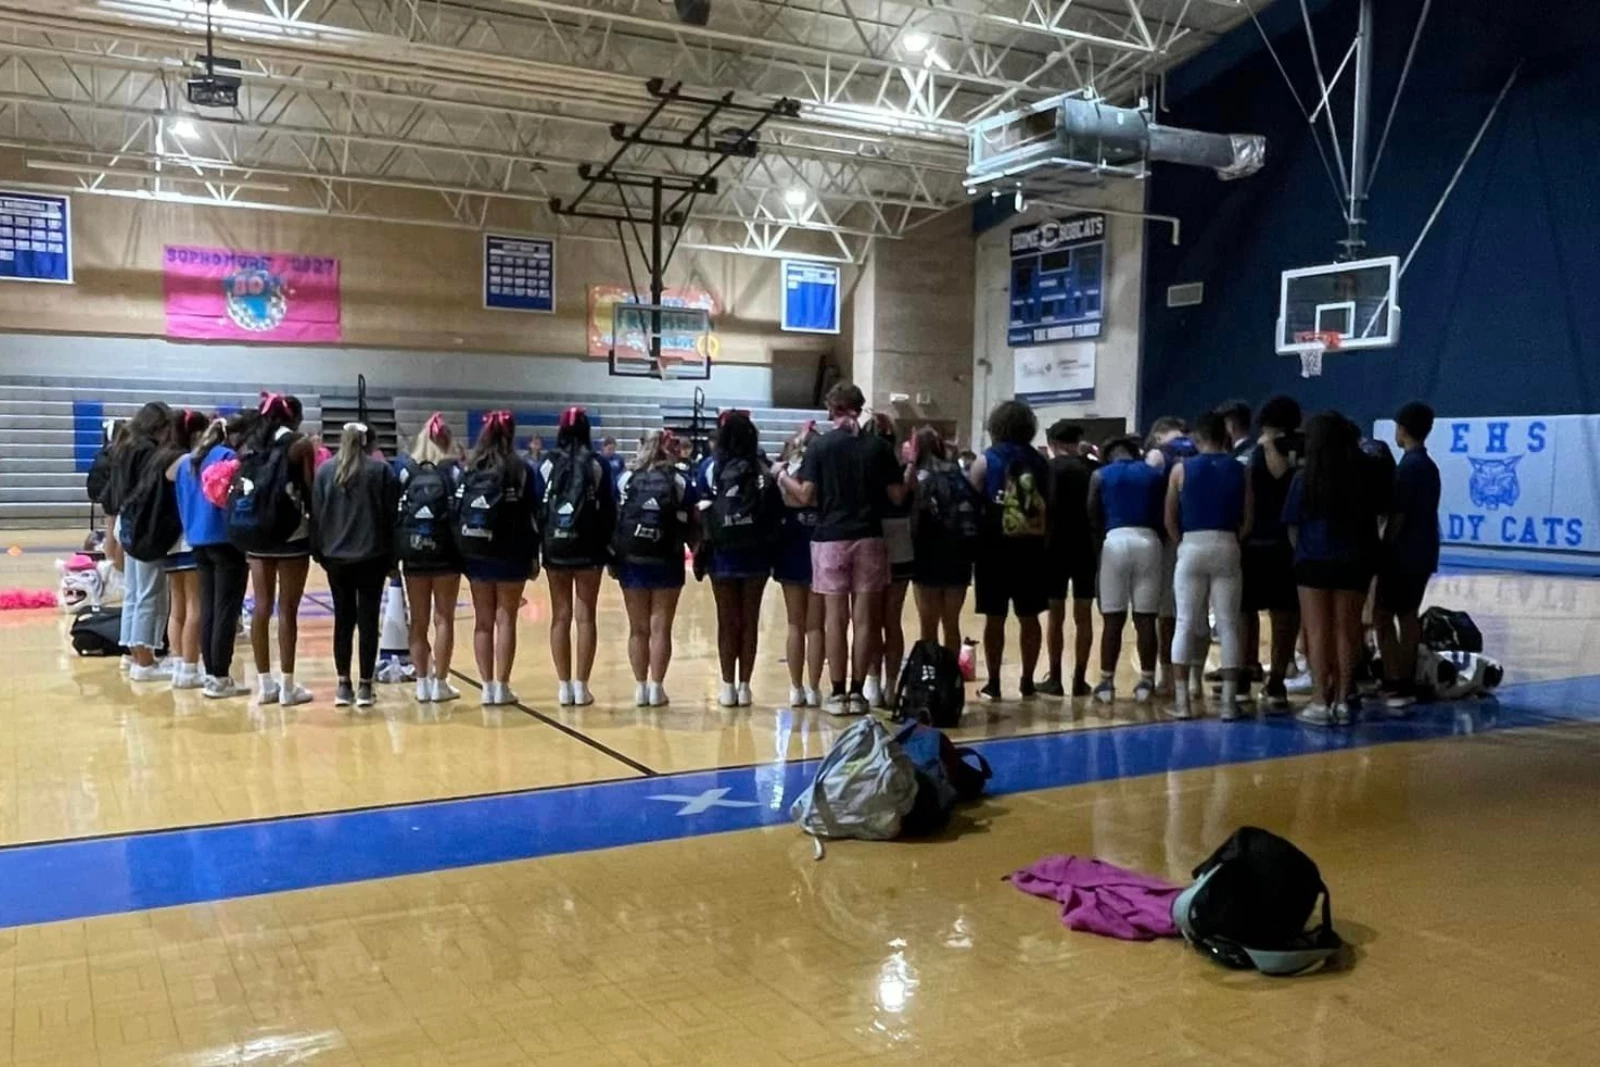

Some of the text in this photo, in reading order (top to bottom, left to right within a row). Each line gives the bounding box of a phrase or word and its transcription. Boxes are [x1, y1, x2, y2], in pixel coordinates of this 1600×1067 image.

[167, 248, 272, 270] SOPHOMORE
[1441, 514, 1583, 546] DY CATS
